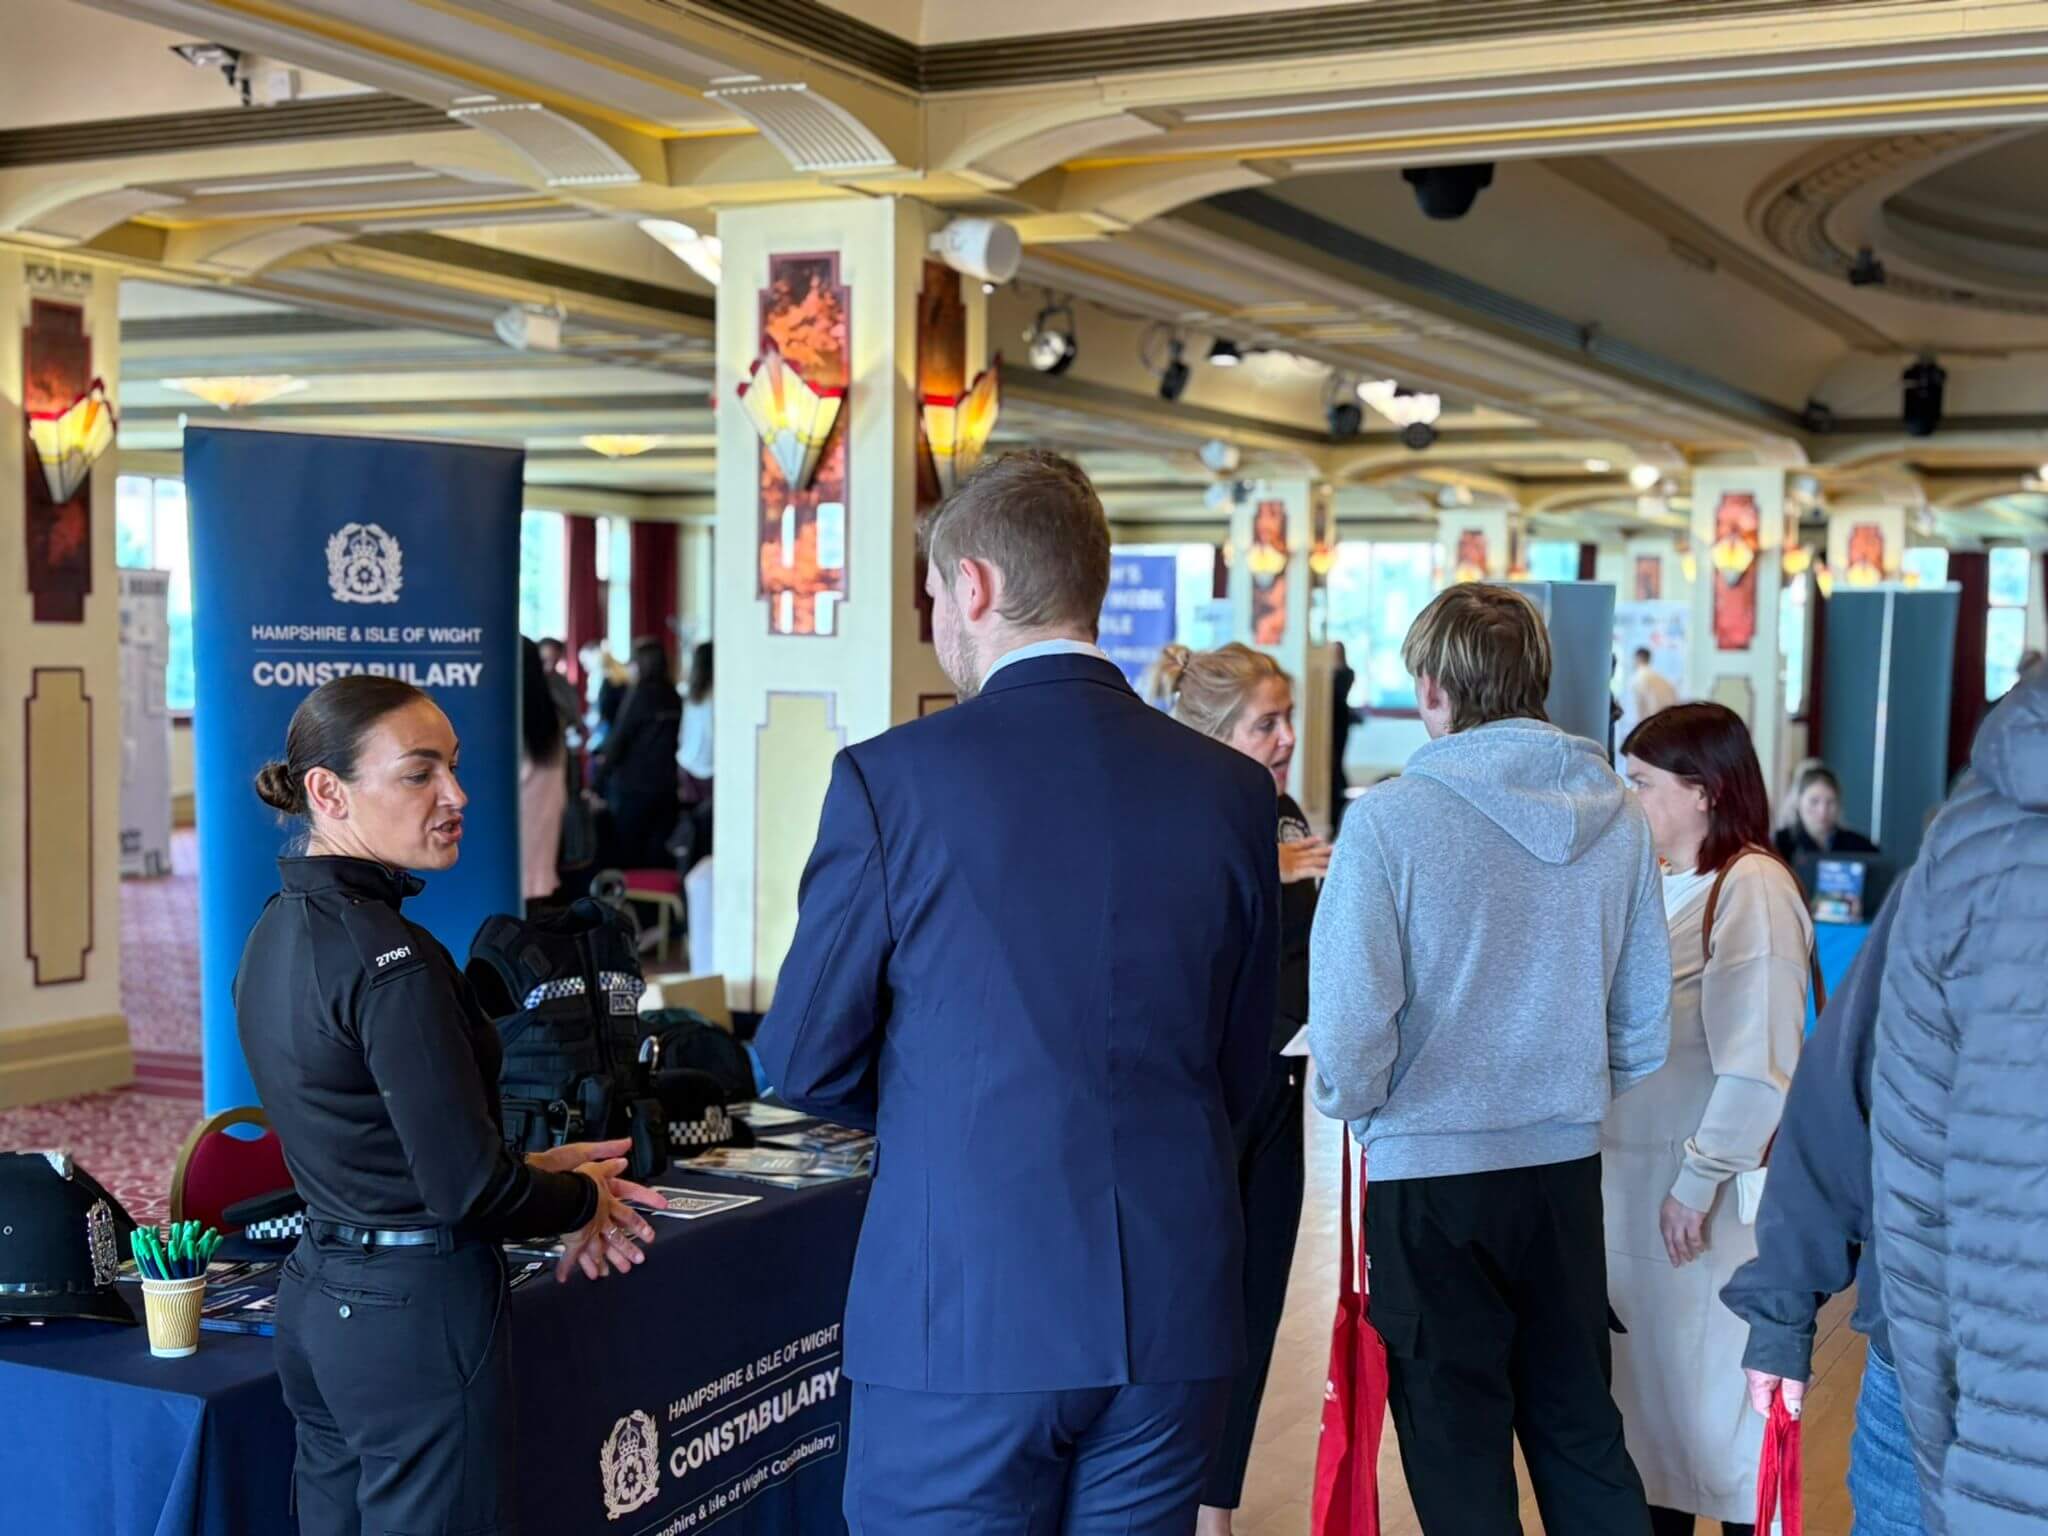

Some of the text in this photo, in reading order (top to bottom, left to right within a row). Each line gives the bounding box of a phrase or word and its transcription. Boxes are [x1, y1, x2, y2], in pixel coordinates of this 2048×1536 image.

[251, 625, 482, 643] HAMPSHIRE & ISLE OF WIGHT
[668, 1323, 840, 1421] HAMPSHIRE & ISLE OF WIGHT
[670, 1367, 840, 1478] CONSTABULARY
[698, 1504, 707, 1520] &
[708, 1494, 727, 1515] Isle
[728, 1484, 741, 1502] of
[742, 1467, 769, 1492] Wight
[770, 1433, 836, 1476] Constabulary
